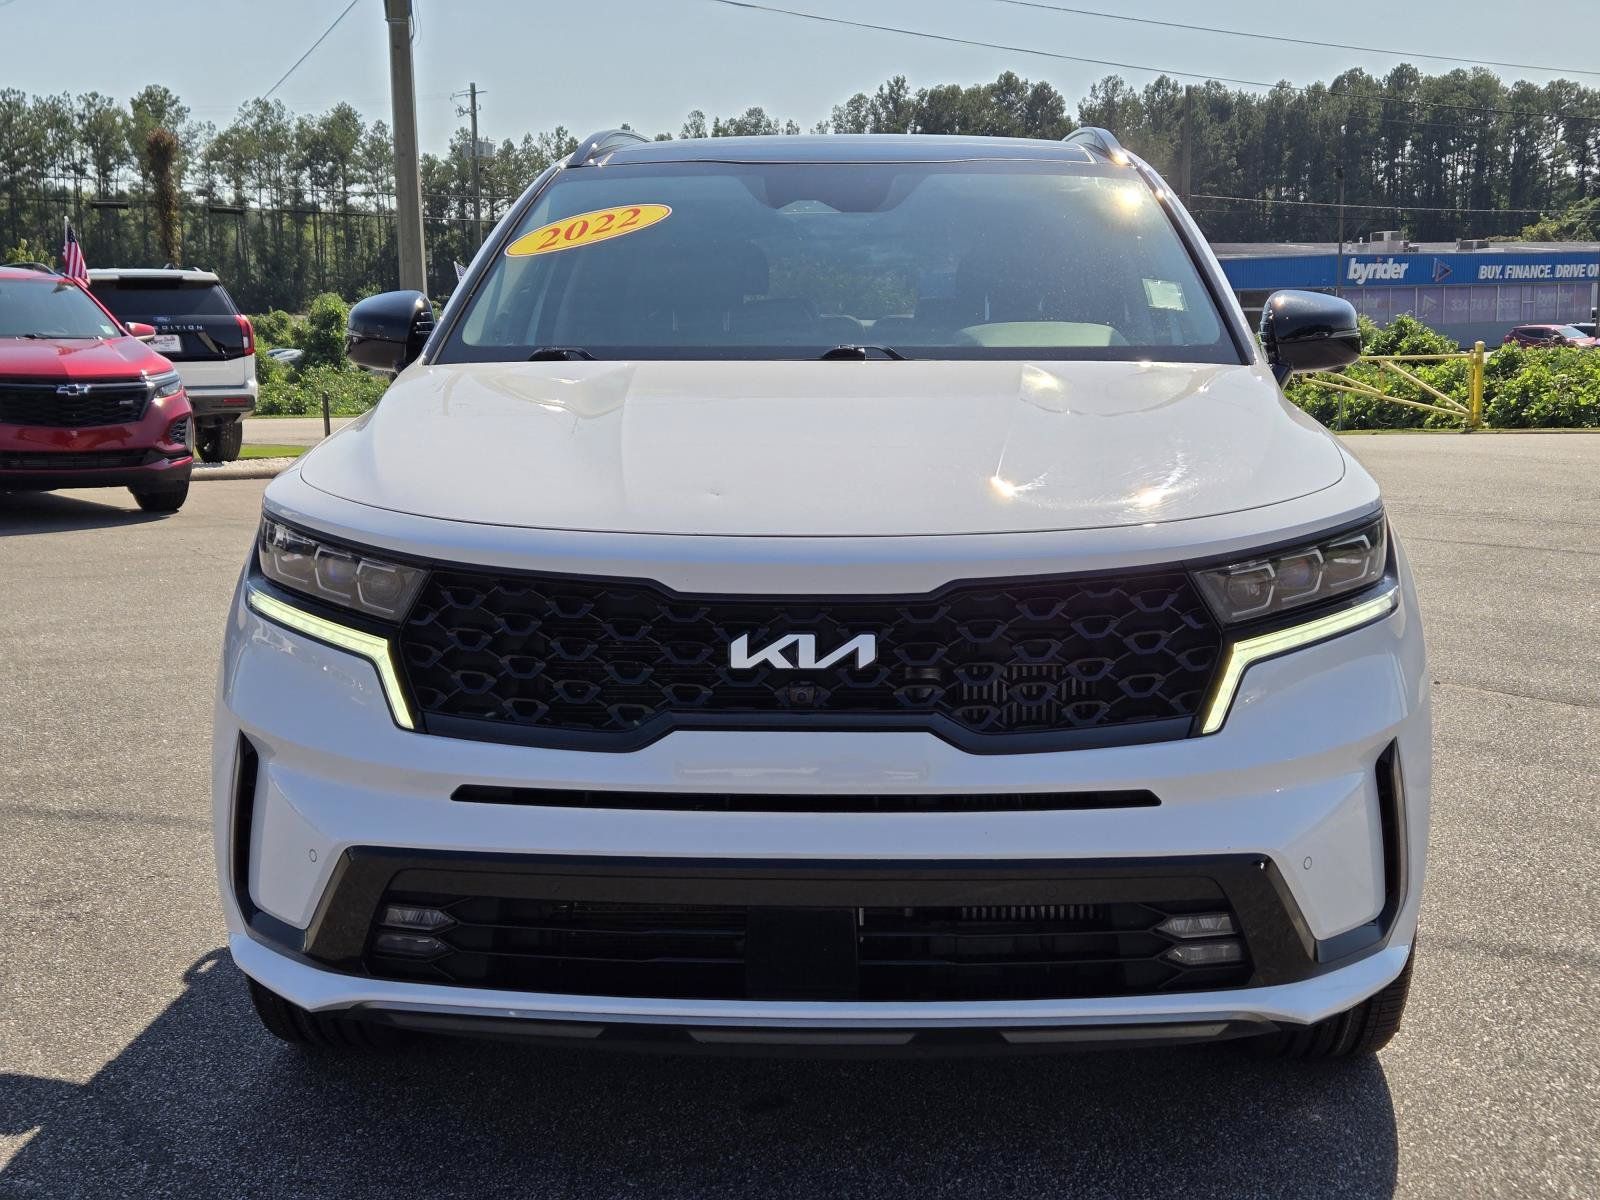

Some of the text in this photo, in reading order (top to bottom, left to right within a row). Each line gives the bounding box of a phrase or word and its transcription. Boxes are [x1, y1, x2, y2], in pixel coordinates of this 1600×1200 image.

[536, 208, 641, 250] 2022
[1347, 257, 1409, 285] byrider
[1478, 265, 1502, 279] BUY.
[1504, 265, 1553, 279] FINANCE.
[1555, 264, 1586, 278] DRIVE
[731, 634, 876, 669] KIA
